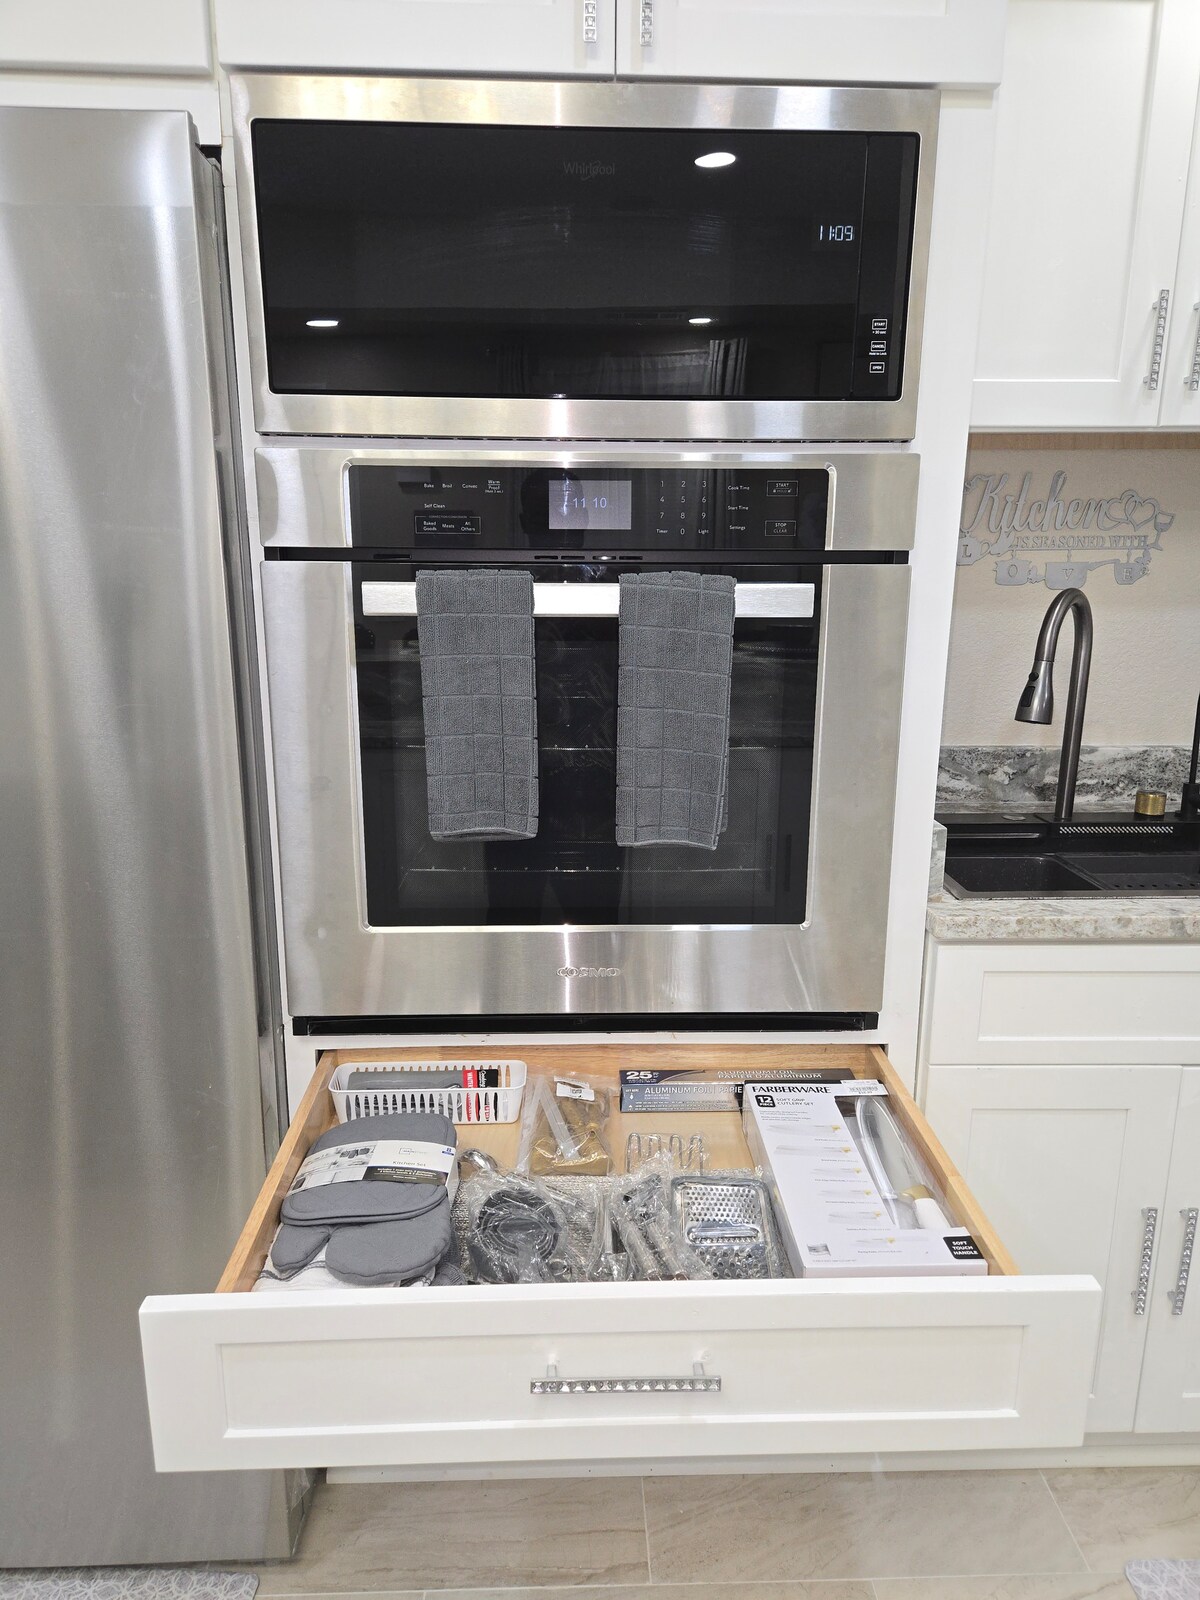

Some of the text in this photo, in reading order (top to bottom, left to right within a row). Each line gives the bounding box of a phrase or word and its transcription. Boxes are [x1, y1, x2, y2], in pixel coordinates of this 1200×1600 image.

[563, 160, 615, 180] Whirlpool
[819, 225, 854, 242] 11:09
[660, 480, 665, 488] 1
[681, 480, 687, 488] 2
[702, 480, 707, 488] 3
[573, 497, 607, 509] 11 10
[961, 470, 1110, 534] Kitchen
[660, 511, 665, 519] 7
[680, 511, 686, 520] 8
[701, 512, 707, 520] 9
[1015, 535, 1150, 549] IS SEASONED WITH
[556, 966, 620, 978] COSMO
[626, 1071, 653, 1080] 25
[719, 1086, 743, 1094] PAPIE
[752, 1086, 831, 1094] FARBERWARE
